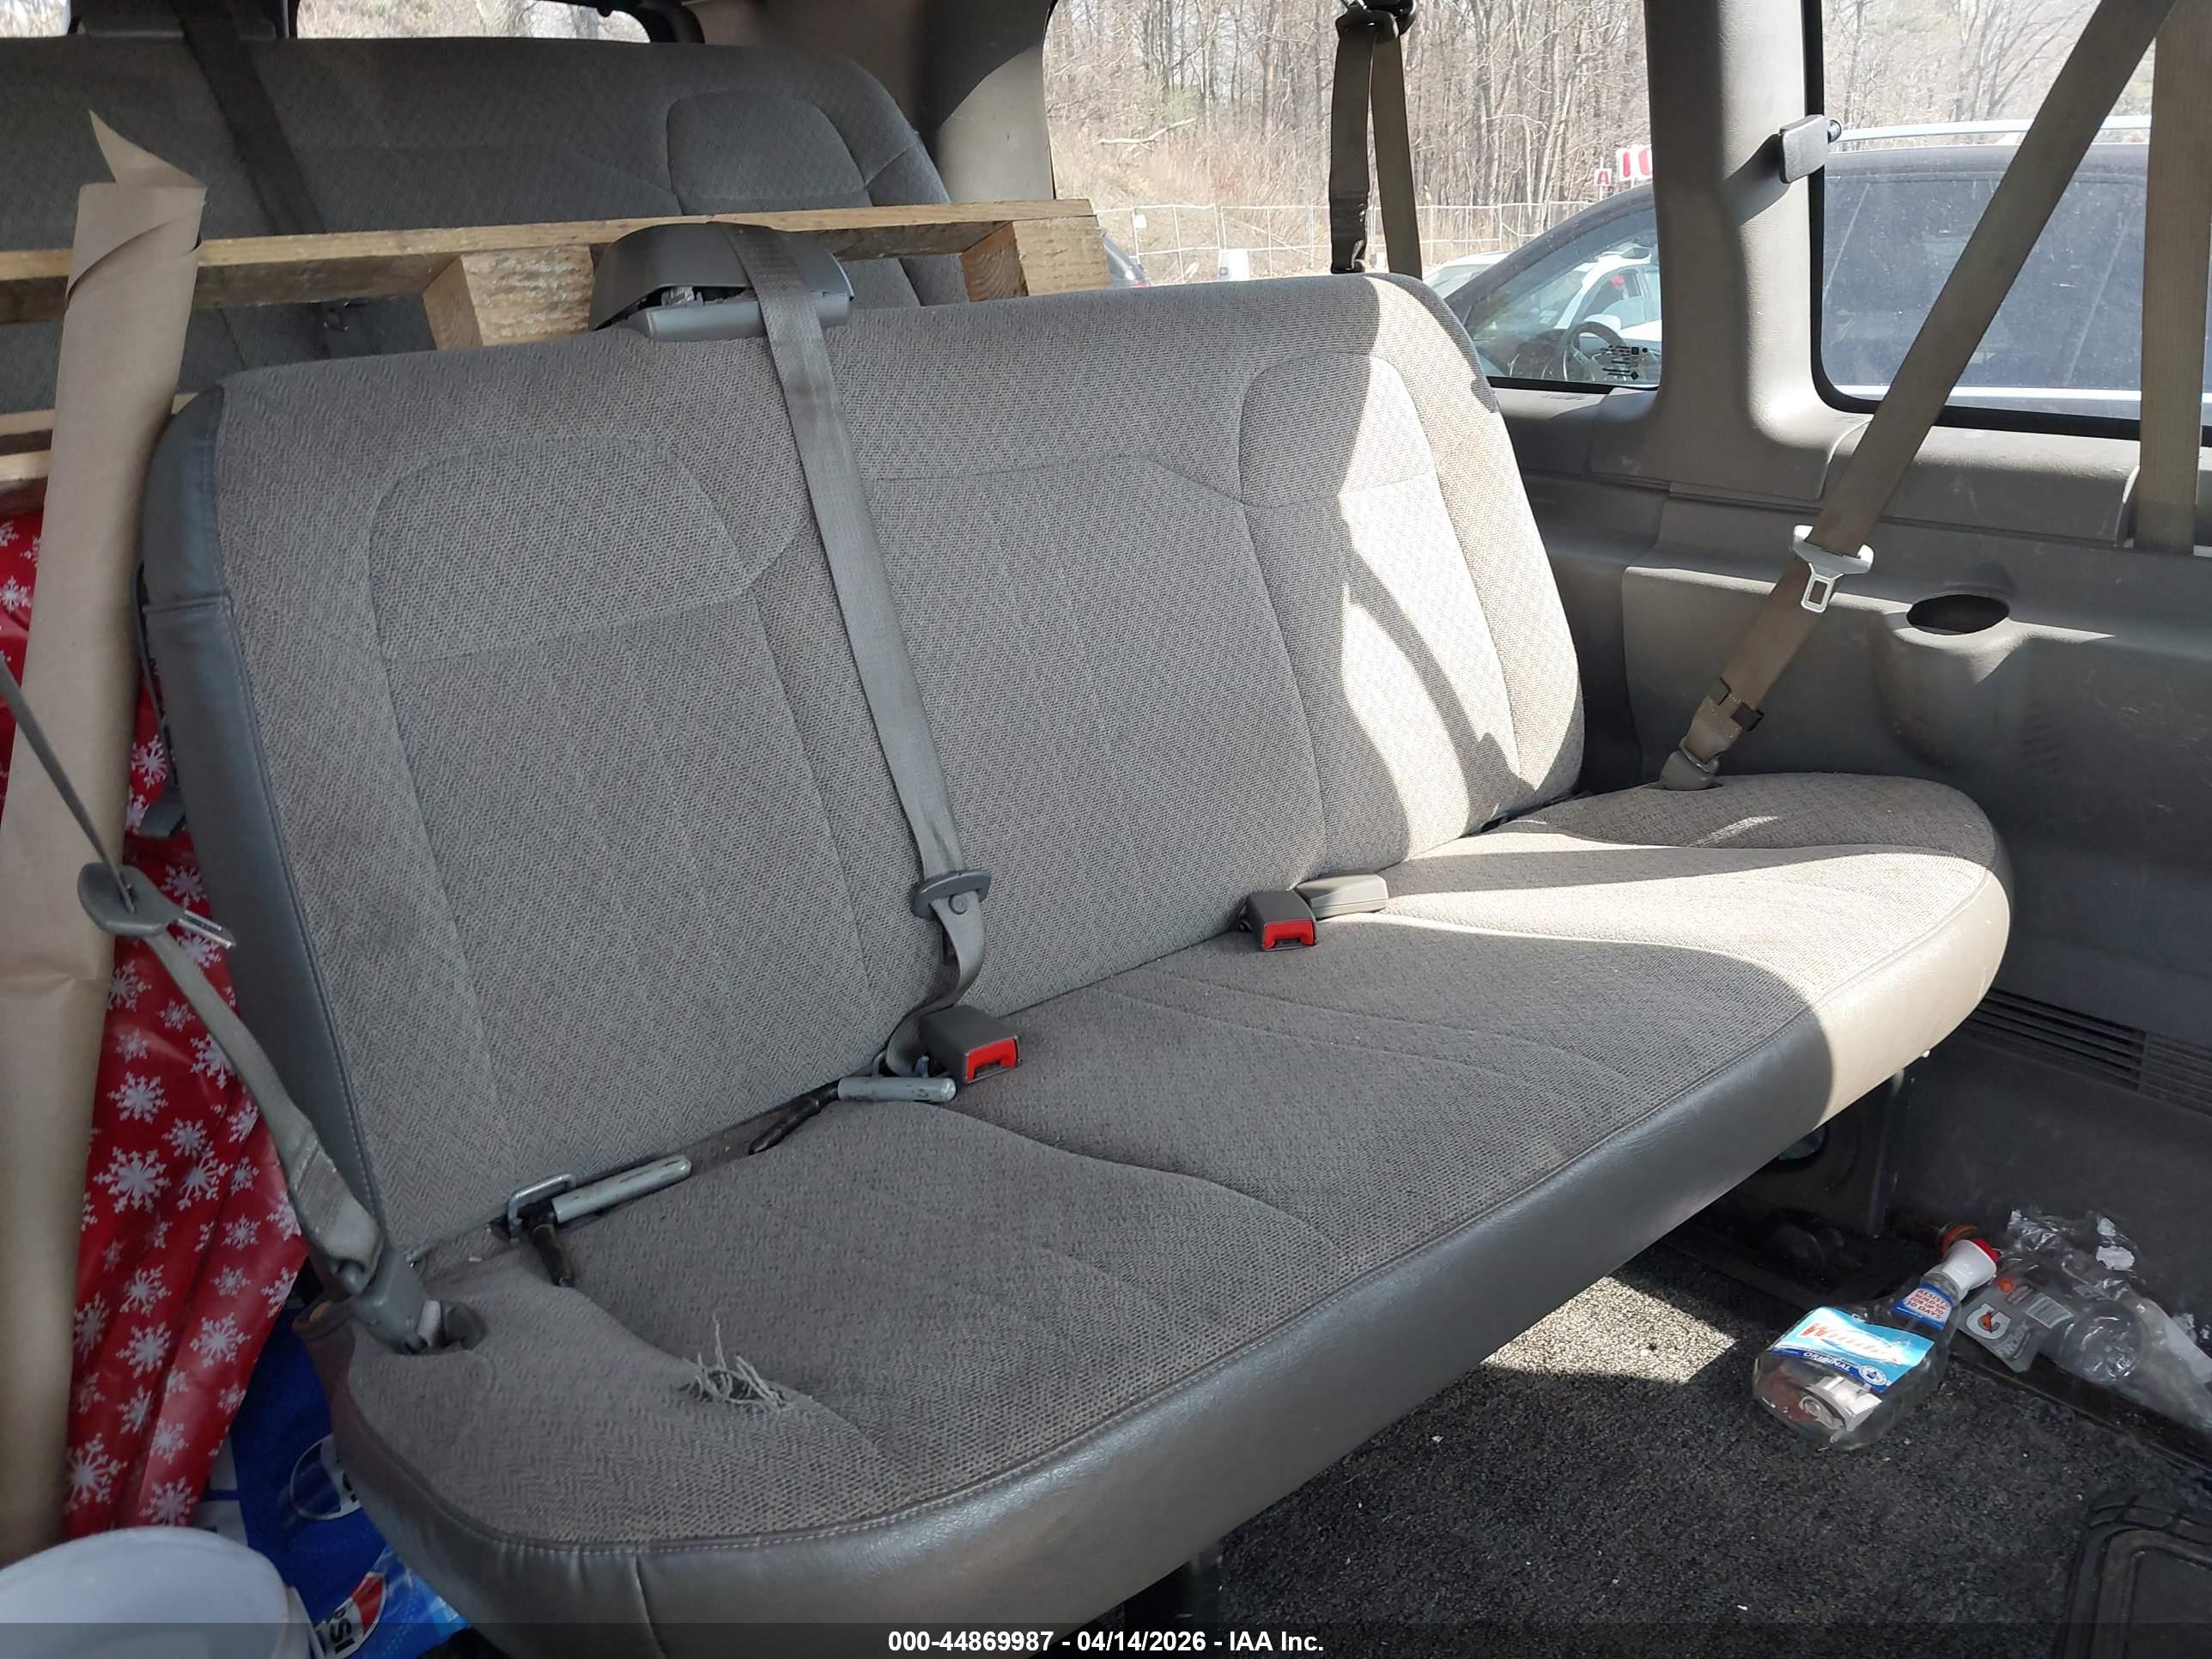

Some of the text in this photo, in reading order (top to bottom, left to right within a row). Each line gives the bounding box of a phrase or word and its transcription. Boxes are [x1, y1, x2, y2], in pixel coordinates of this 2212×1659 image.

[1596, 171, 1609, 185] A
[1917, 1305, 1942, 1320] DAYS
[1966, 1303, 2012, 1340] G
[1802, 1351, 1851, 1372] ORIGINAL
